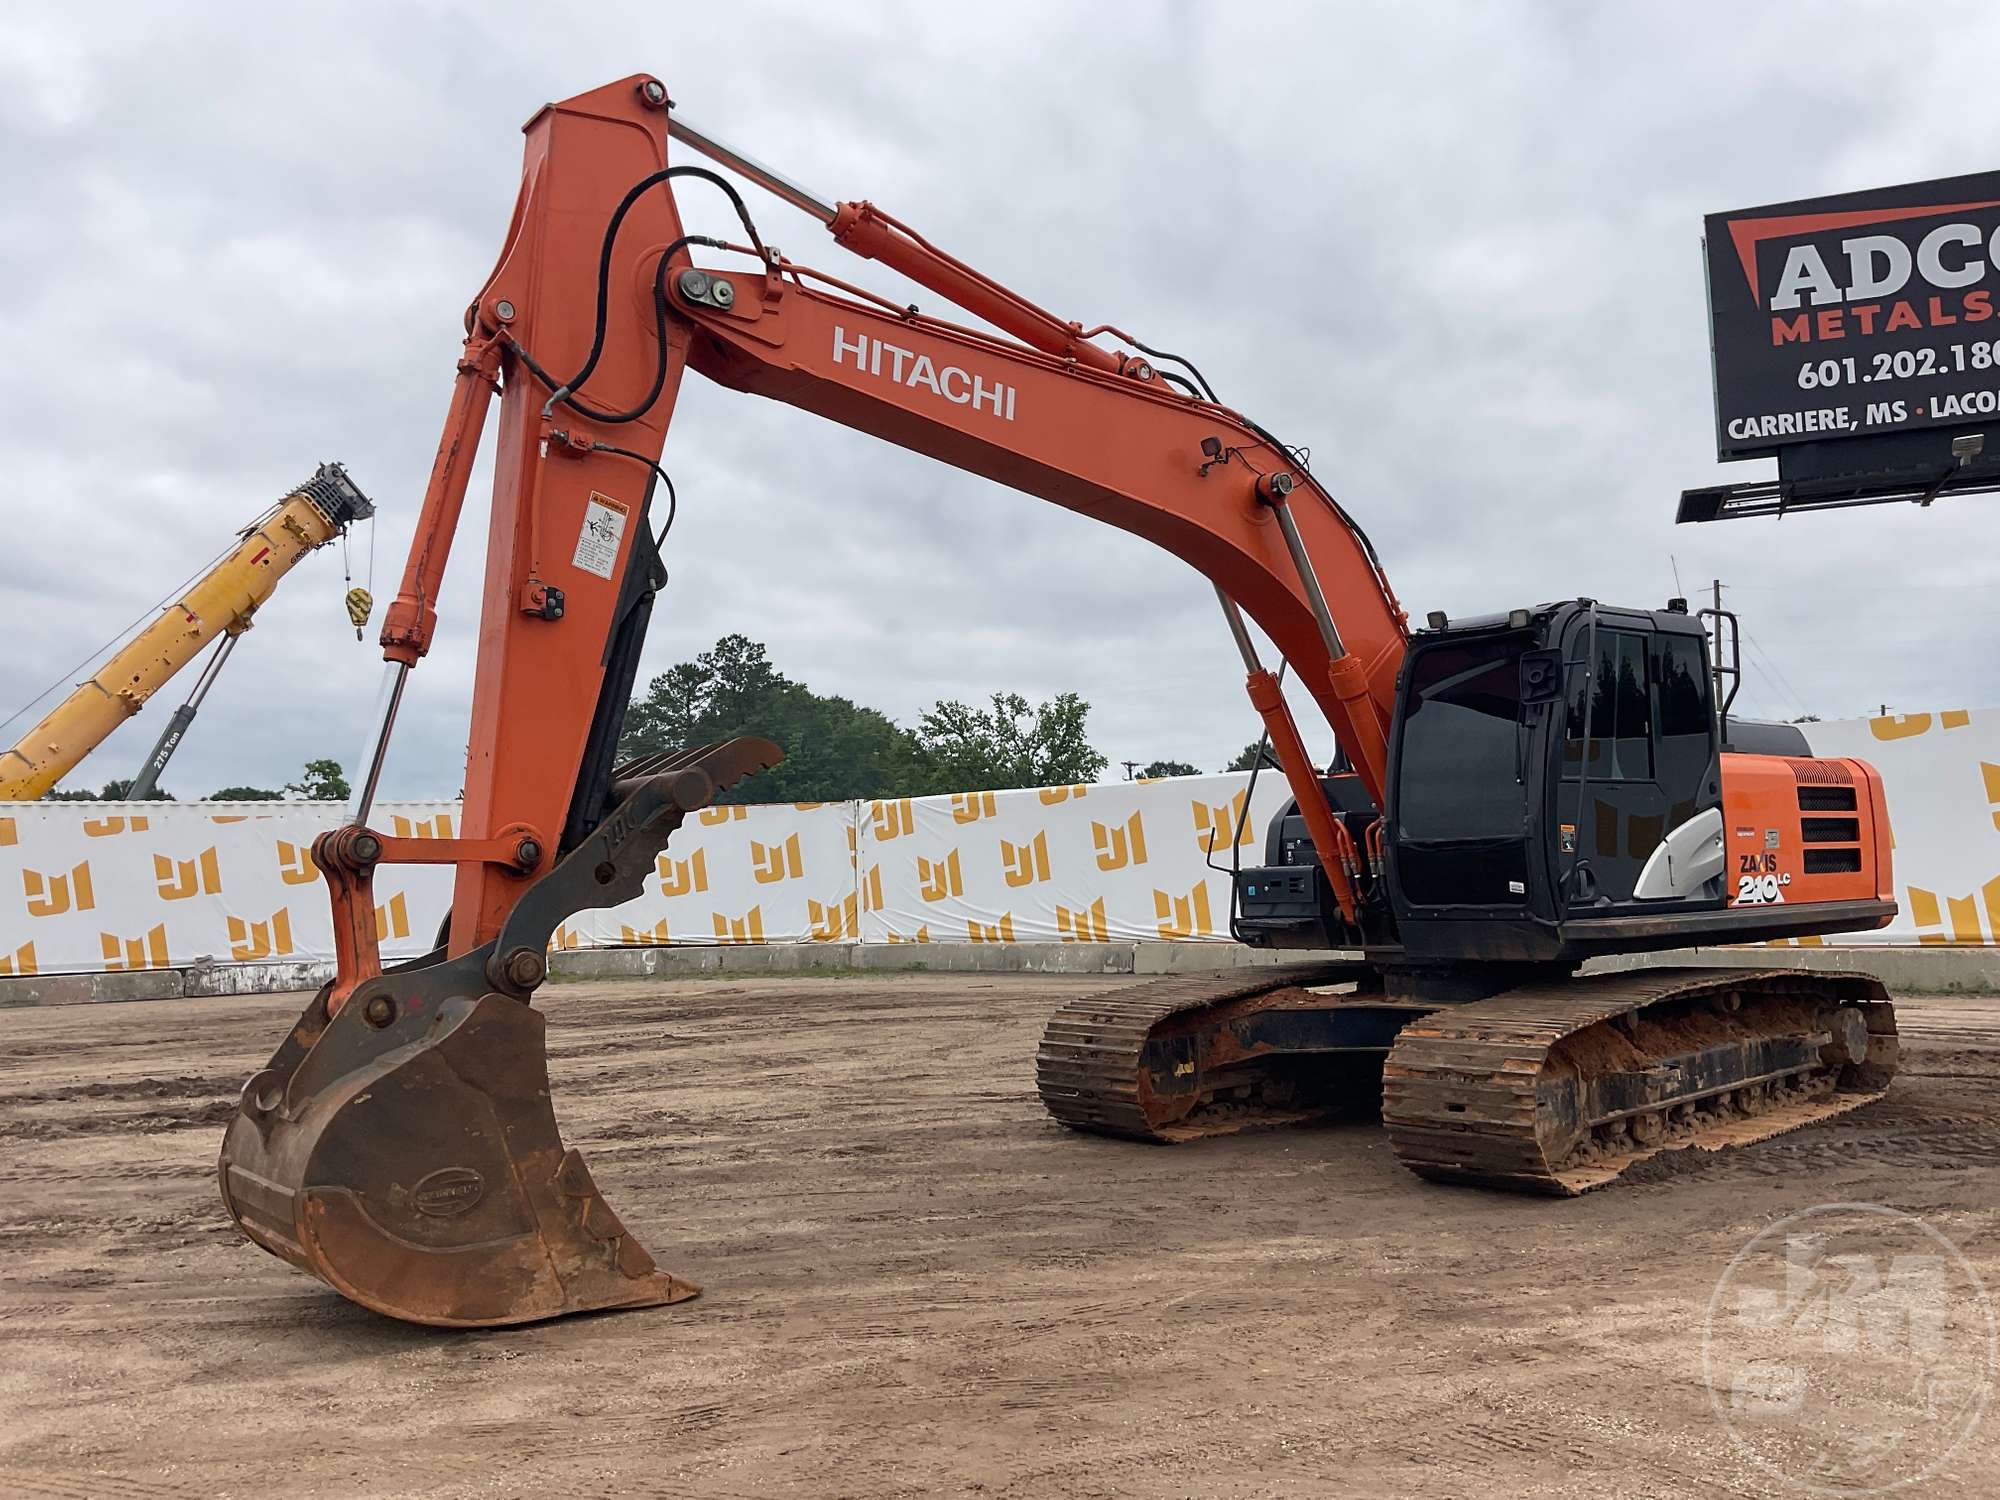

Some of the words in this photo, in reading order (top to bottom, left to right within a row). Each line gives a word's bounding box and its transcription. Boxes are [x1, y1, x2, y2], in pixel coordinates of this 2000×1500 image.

[1770, 223, 2000, 311] ADC
[832, 326, 1015, 421] HITACHI
[1728, 407, 1858, 440] CARRIERE,
[1866, 401, 1908, 425] MS
[1930, 390, 2000, 418] LACO
[153, 750, 169, 769] 275
[164, 731, 180, 749] Ton
[1740, 850, 1777, 873] ZAXIS
